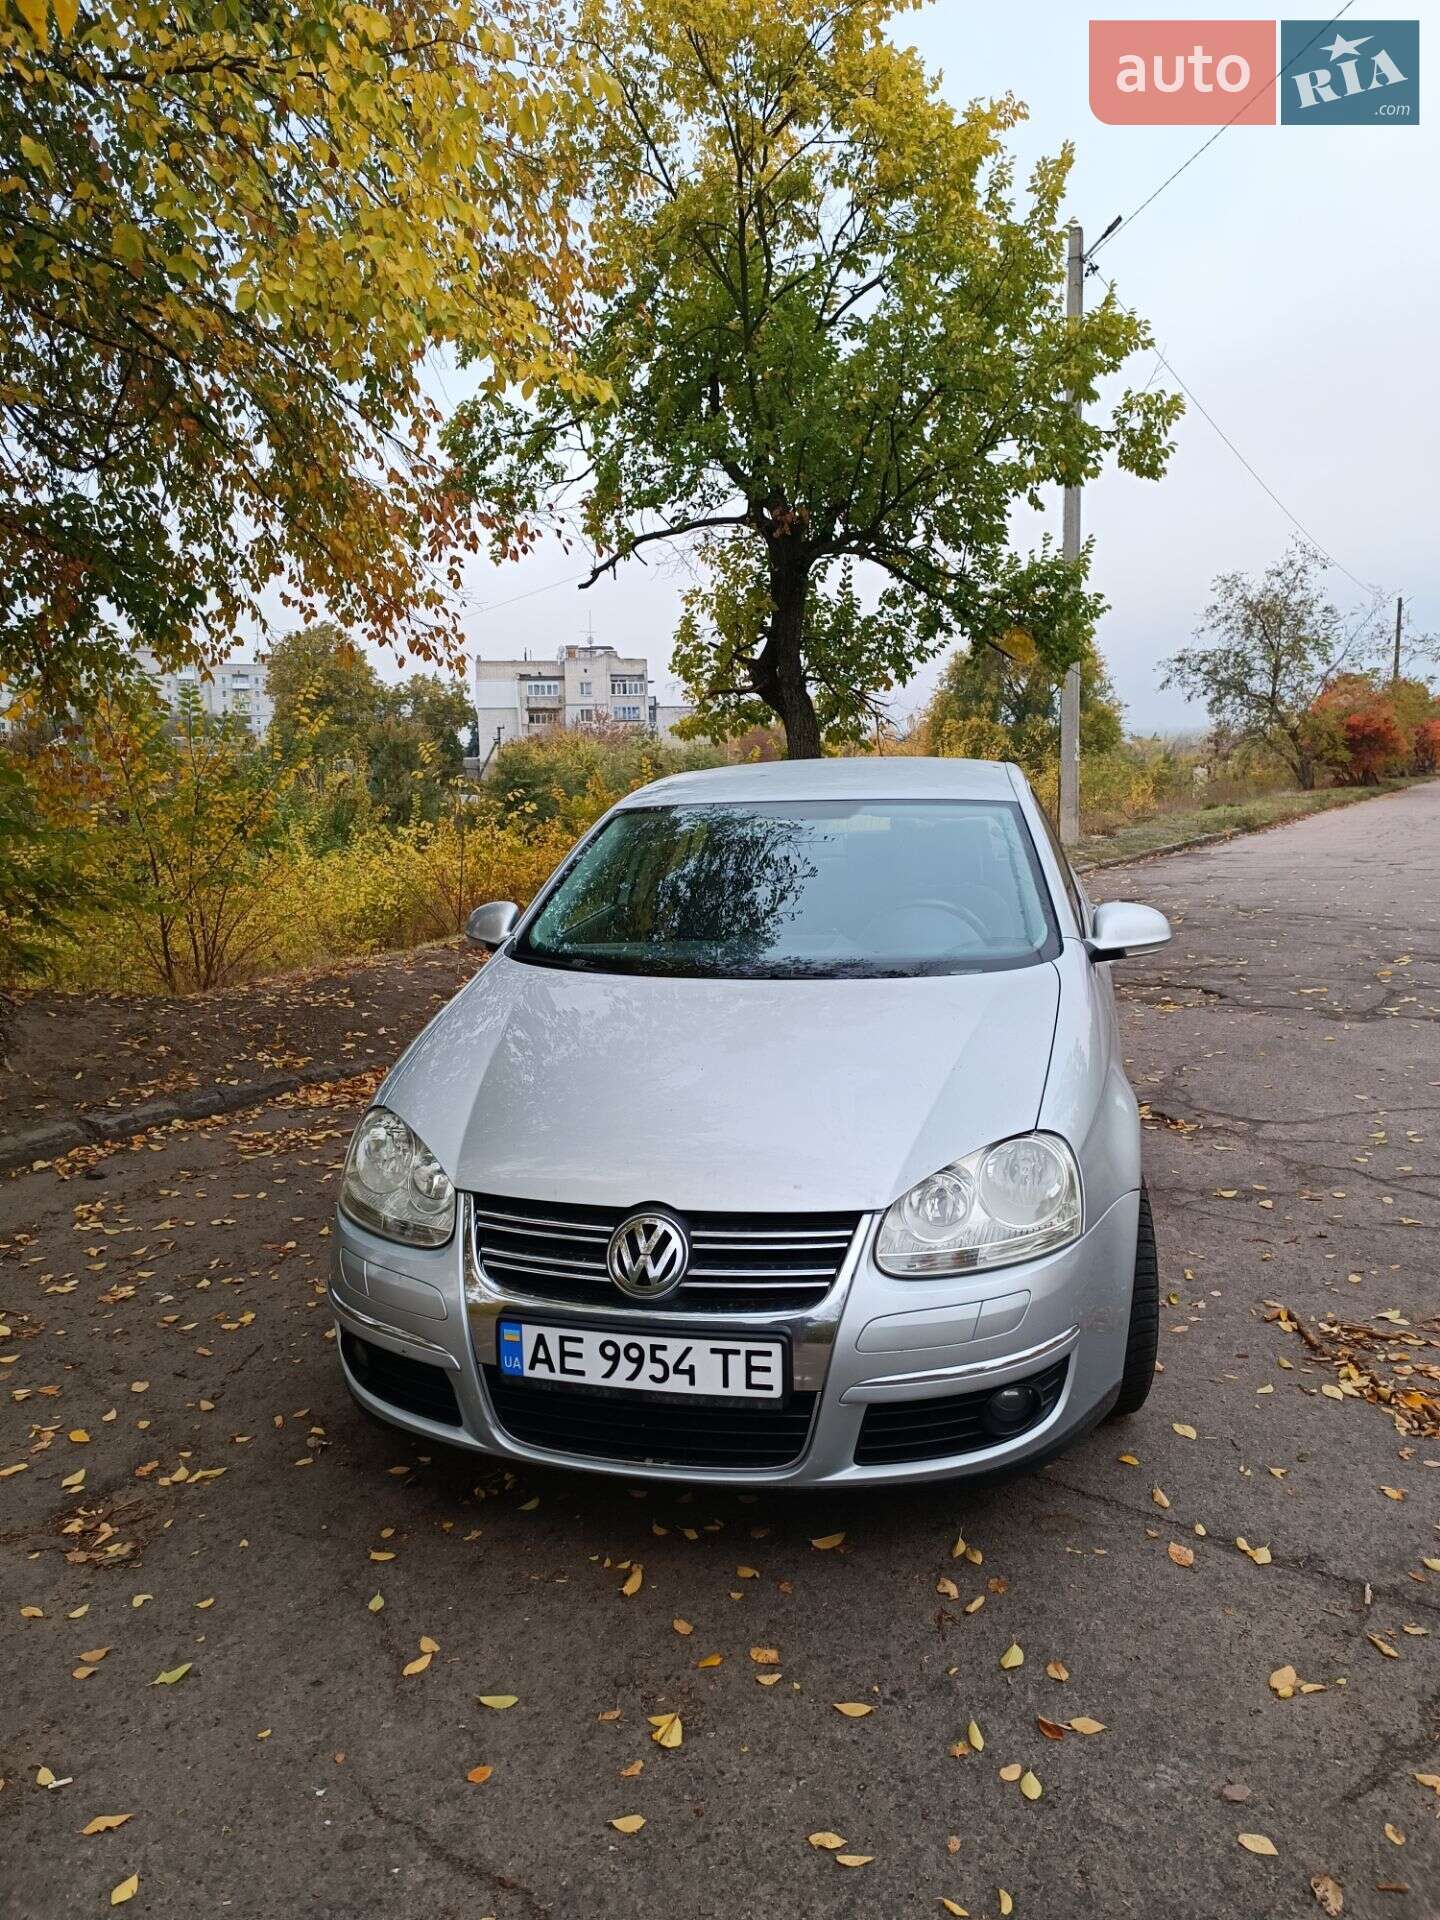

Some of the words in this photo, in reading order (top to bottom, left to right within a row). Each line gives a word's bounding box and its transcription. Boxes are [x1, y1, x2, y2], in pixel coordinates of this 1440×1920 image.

[610, 1214, 686, 1295] VW
[504, 1355, 521, 1369] UA
[528, 1333, 586, 1376] AE
[598, 1339, 696, 1386] 9954
[709, 1347, 774, 1391] TE
